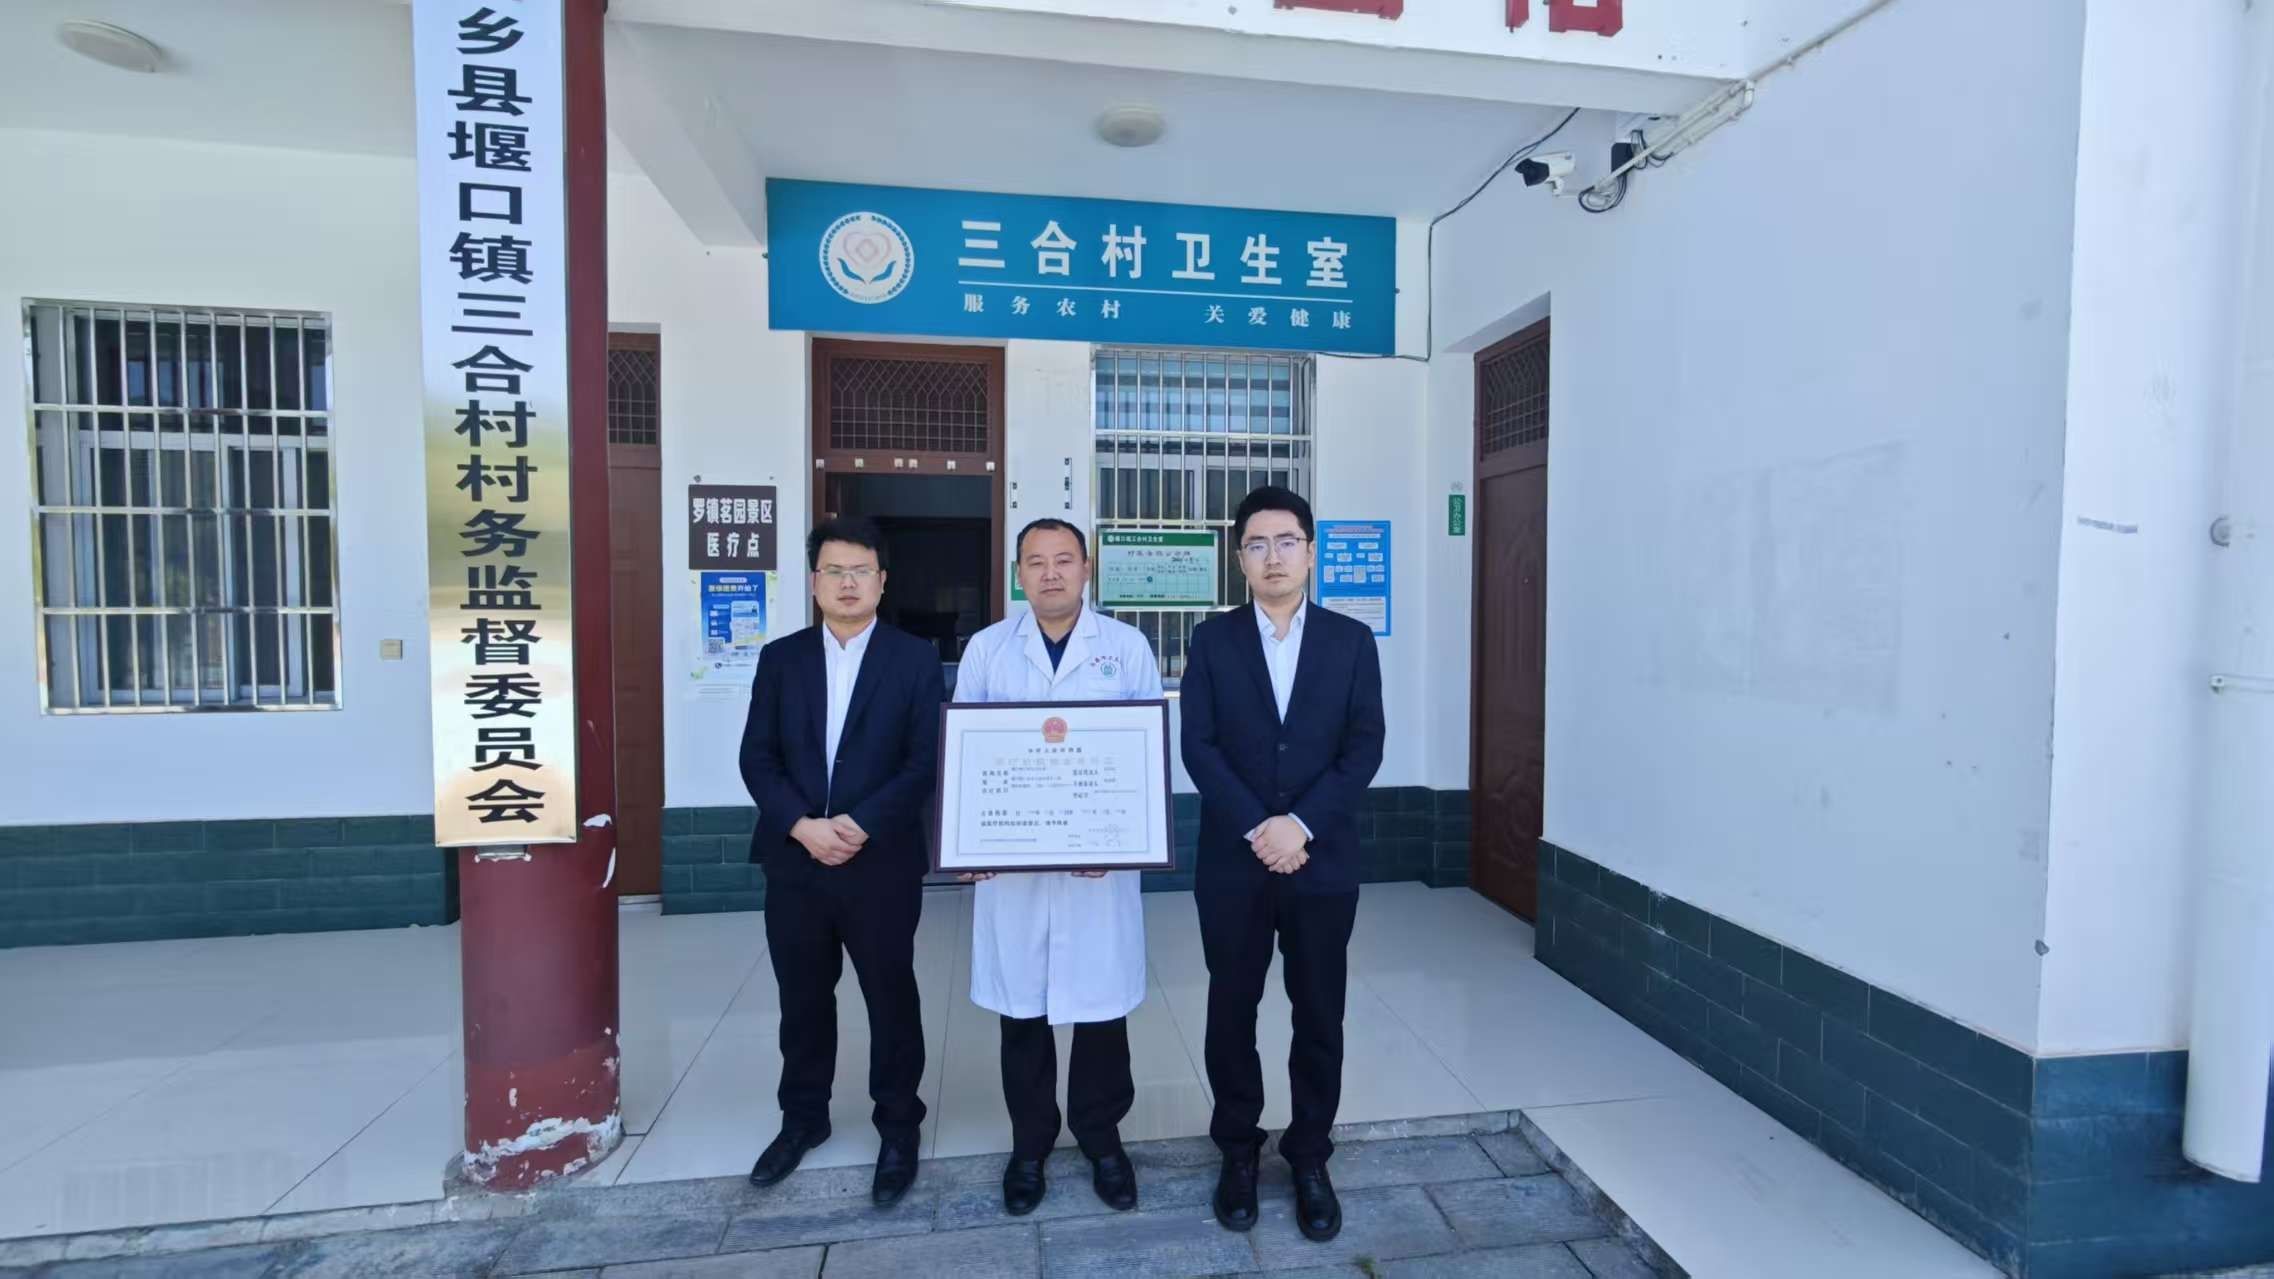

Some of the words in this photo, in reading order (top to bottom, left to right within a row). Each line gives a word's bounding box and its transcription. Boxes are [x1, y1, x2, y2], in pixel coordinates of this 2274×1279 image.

[958, 220, 1349, 289] 三合村卫生室
[964, 293, 1121, 320] 服务农村
[1204, 304, 1352, 329] 关爱健康
[447, 7, 546, 824] 乡县堰口镇三合村村务监督委员会
[707, 532, 760, 557] 医疗点
